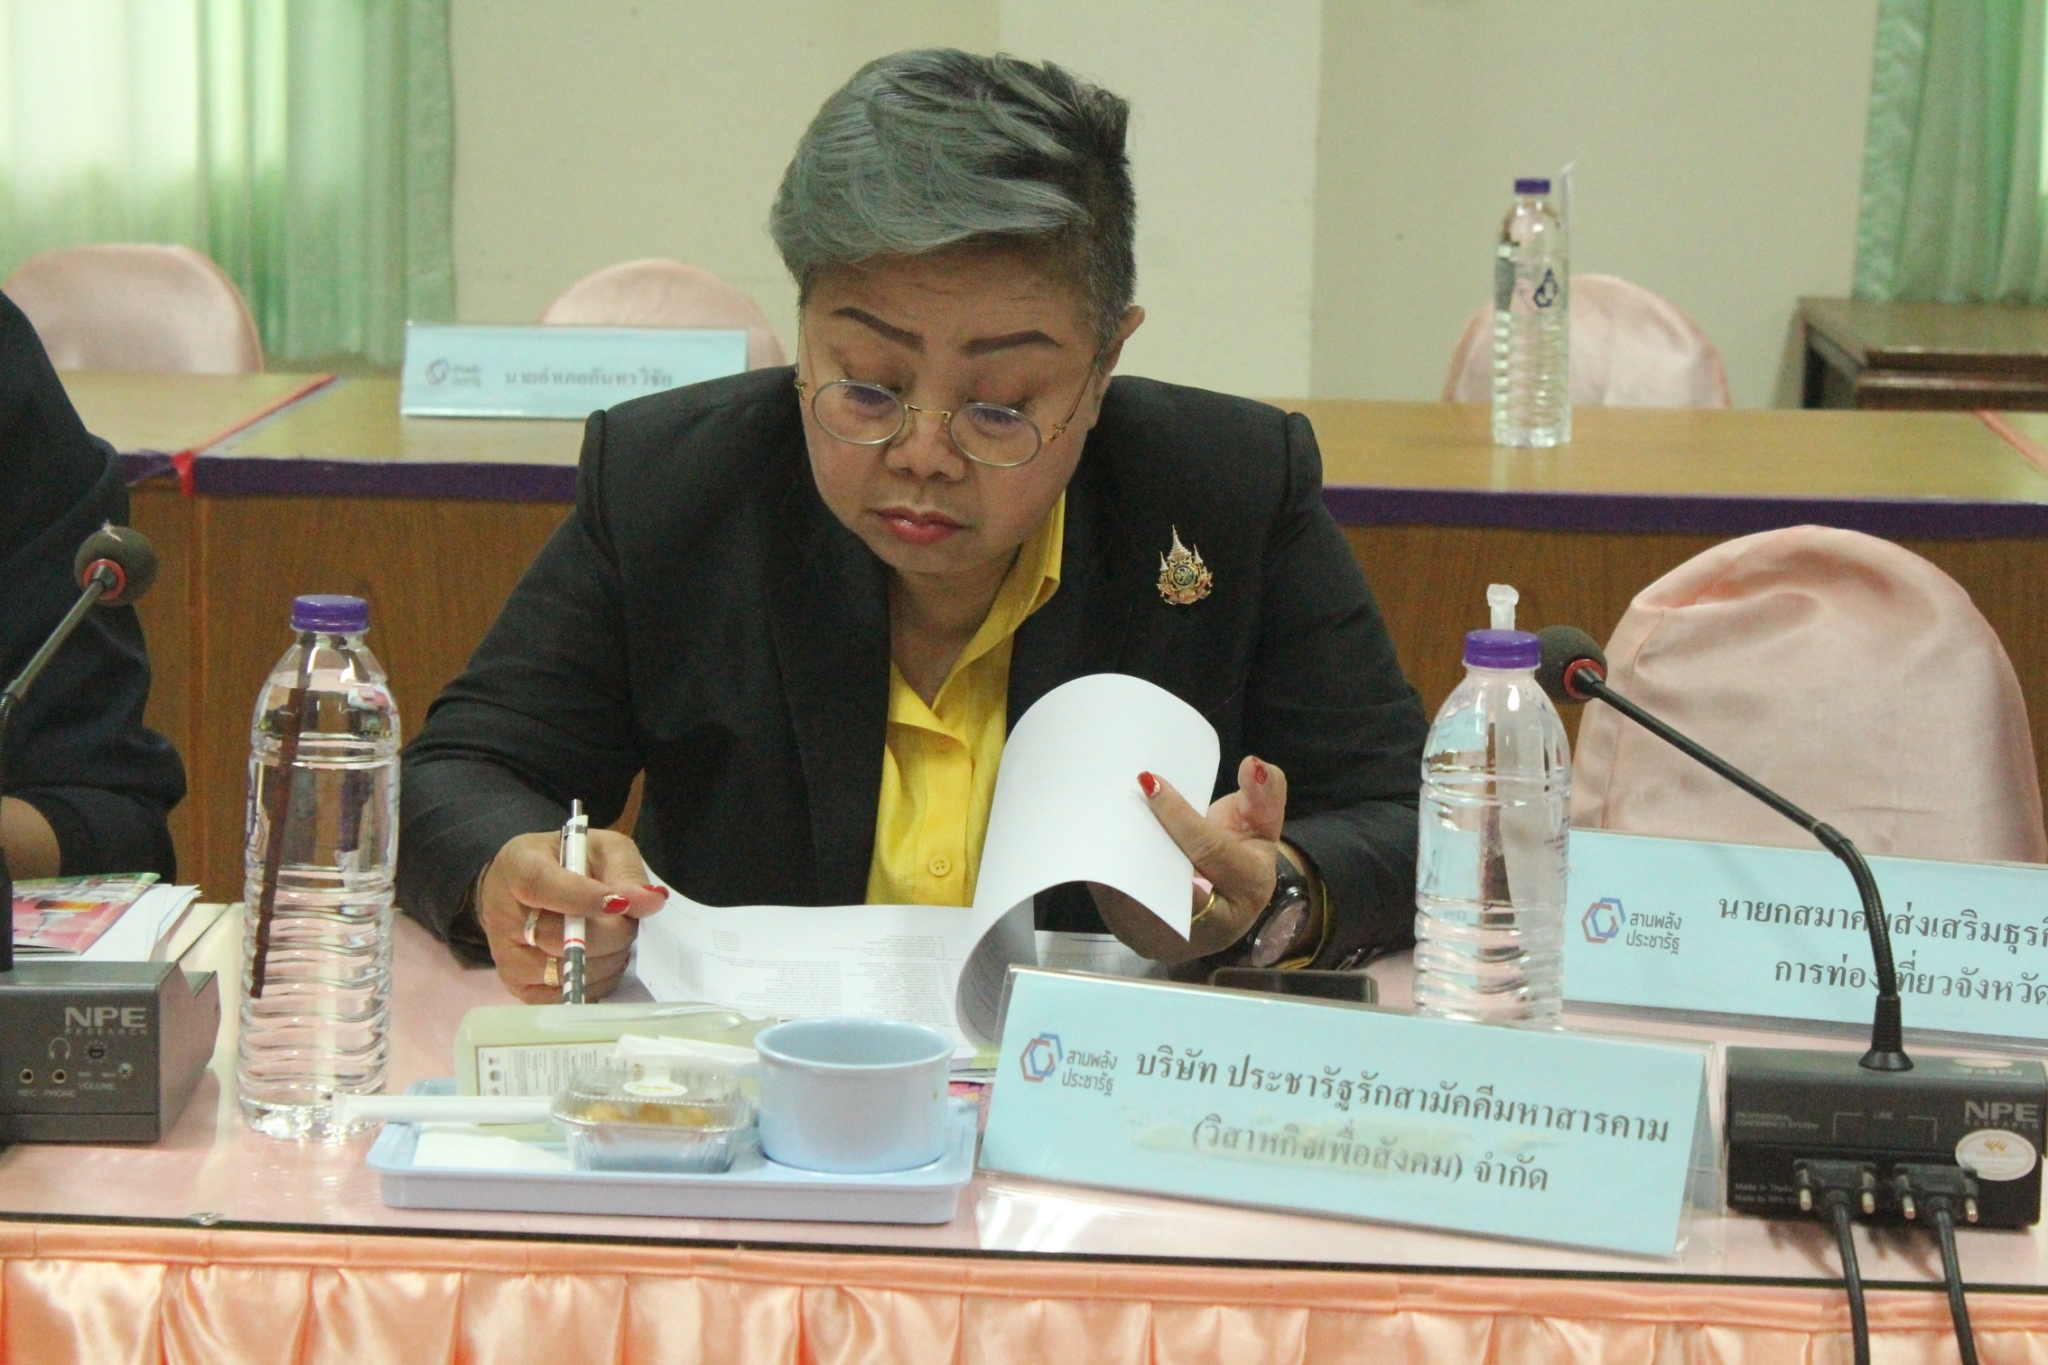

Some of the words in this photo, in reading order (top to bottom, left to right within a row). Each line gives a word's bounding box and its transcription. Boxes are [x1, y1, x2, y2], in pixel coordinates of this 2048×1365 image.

[1629, 911, 1682, 930] สานพลัง
[1718, 897, 2048, 955] นายกสมาคส่งเสริมธุร
[1626, 929, 1680, 955] ประชารัฐ
[65, 1007, 147, 1027] NPE
[1066, 1048, 1118, 1071] สานพลัง
[1061, 1067, 1114, 1097] ประชารัฐ
[1135, 1045, 1217, 1085] บริษัท
[1228, 1053, 1670, 1144] ประชารัฐรักสามัคคีมหาสารคาม
[1964, 1100, 2038, 1122] NPE
[1192, 1113, 1463, 1184] (วิสาหกิจเพื่อสังคม)
[1474, 1151, 1549, 1192] จำกัด
